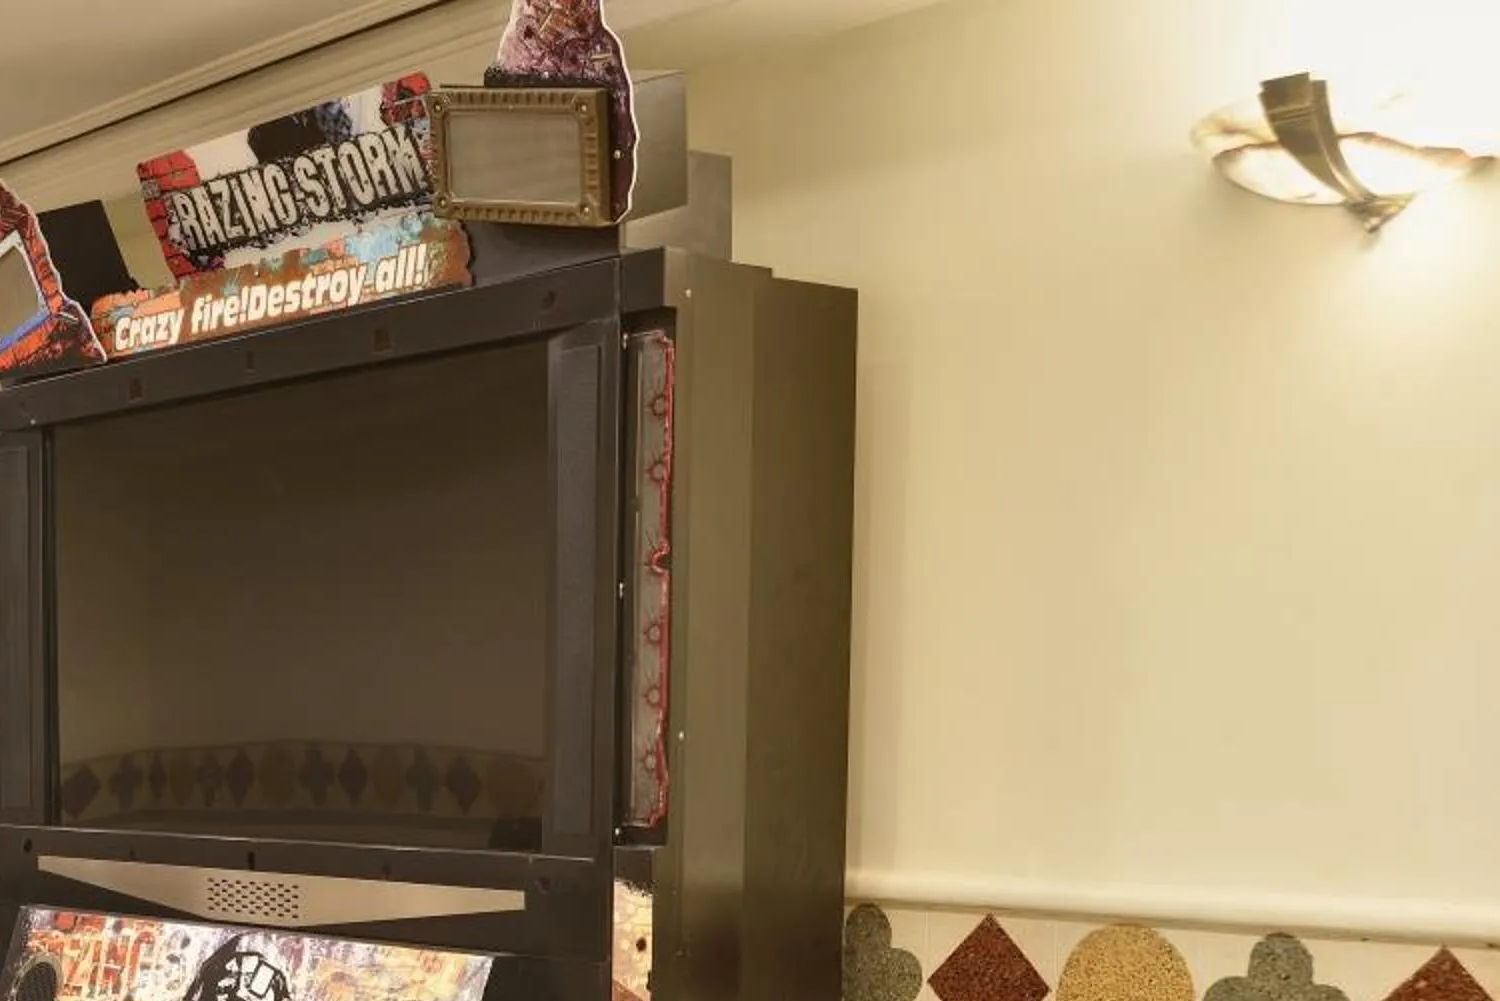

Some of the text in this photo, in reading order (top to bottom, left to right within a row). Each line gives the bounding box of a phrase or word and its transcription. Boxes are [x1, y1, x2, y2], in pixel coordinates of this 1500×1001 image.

[175, 124, 426, 249] RAZING STORM
[115, 306, 184, 350] Crazy
[374, 243, 427, 293] all!
